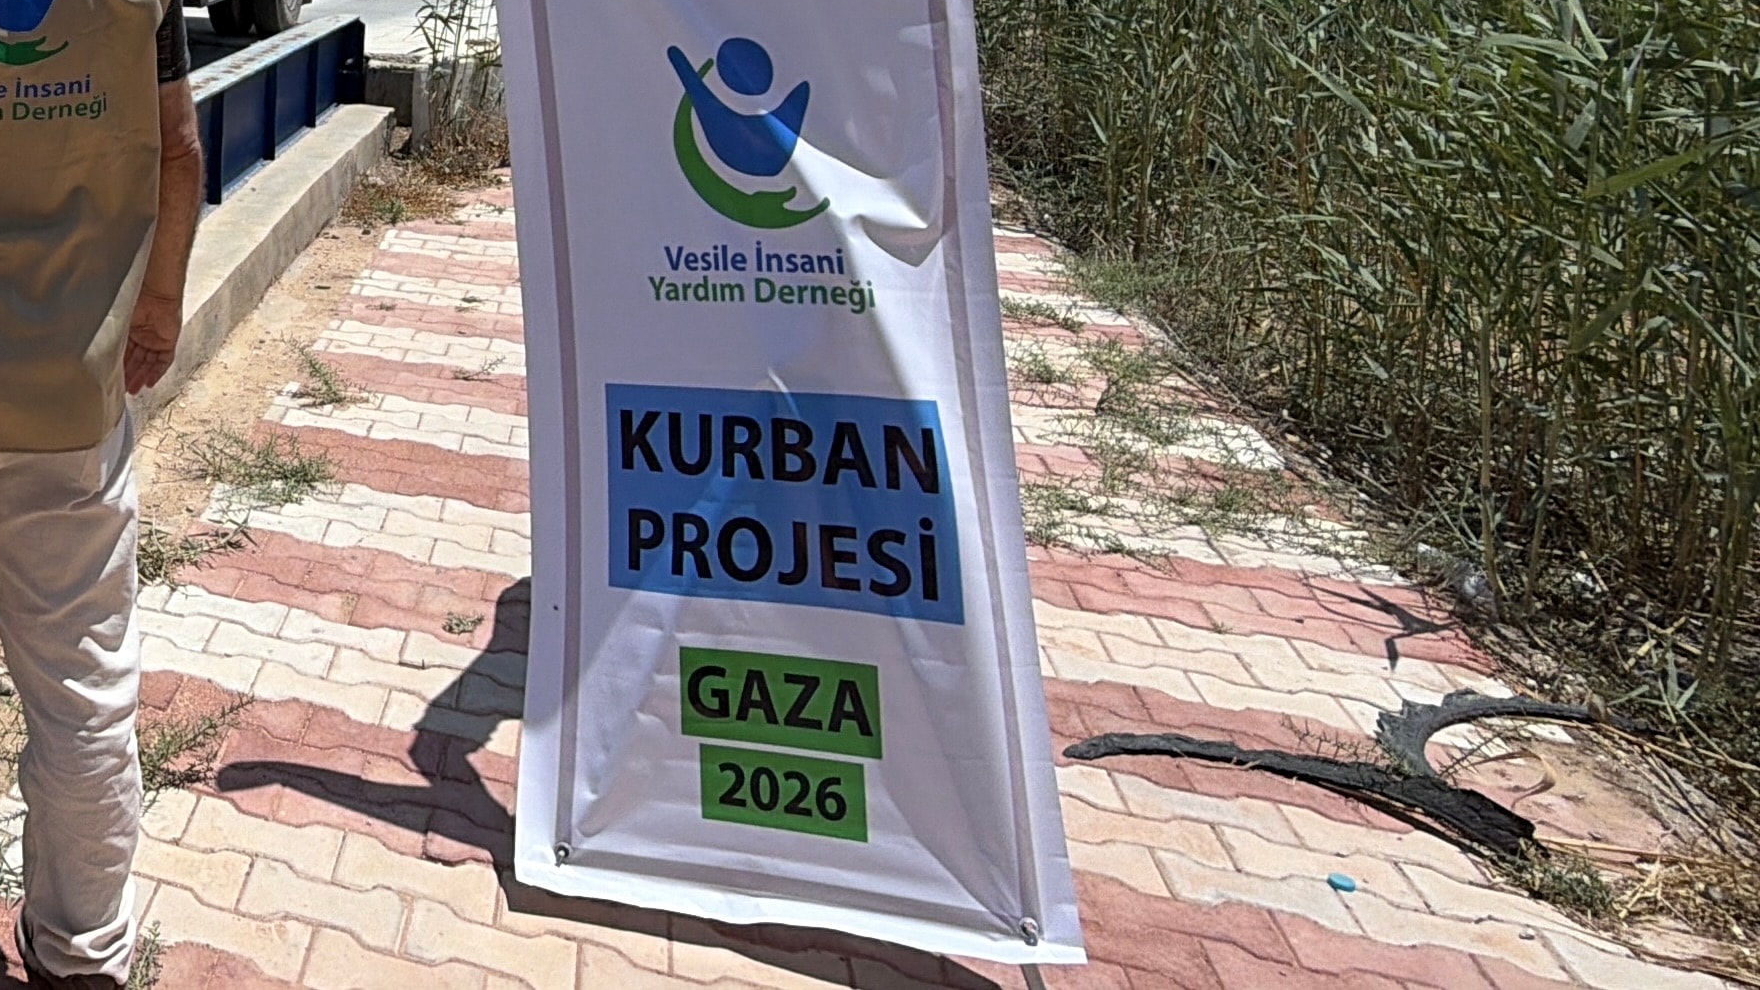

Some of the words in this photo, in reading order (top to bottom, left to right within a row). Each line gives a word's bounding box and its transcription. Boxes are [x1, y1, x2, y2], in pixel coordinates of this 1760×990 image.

[12, 92, 107, 120] Derneği
[15, 74, 91, 98] İnsani
[664, 244, 748, 274] Vesile
[755, 240, 844, 275] İnsani
[648, 275, 744, 305] Yardım
[754, 278, 875, 314] Derneği
[620, 409, 939, 495] KURBAN
[627, 507, 939, 602] PROJESİ
[686, 664, 874, 737] GAZA
[718, 762, 848, 822] 2026
